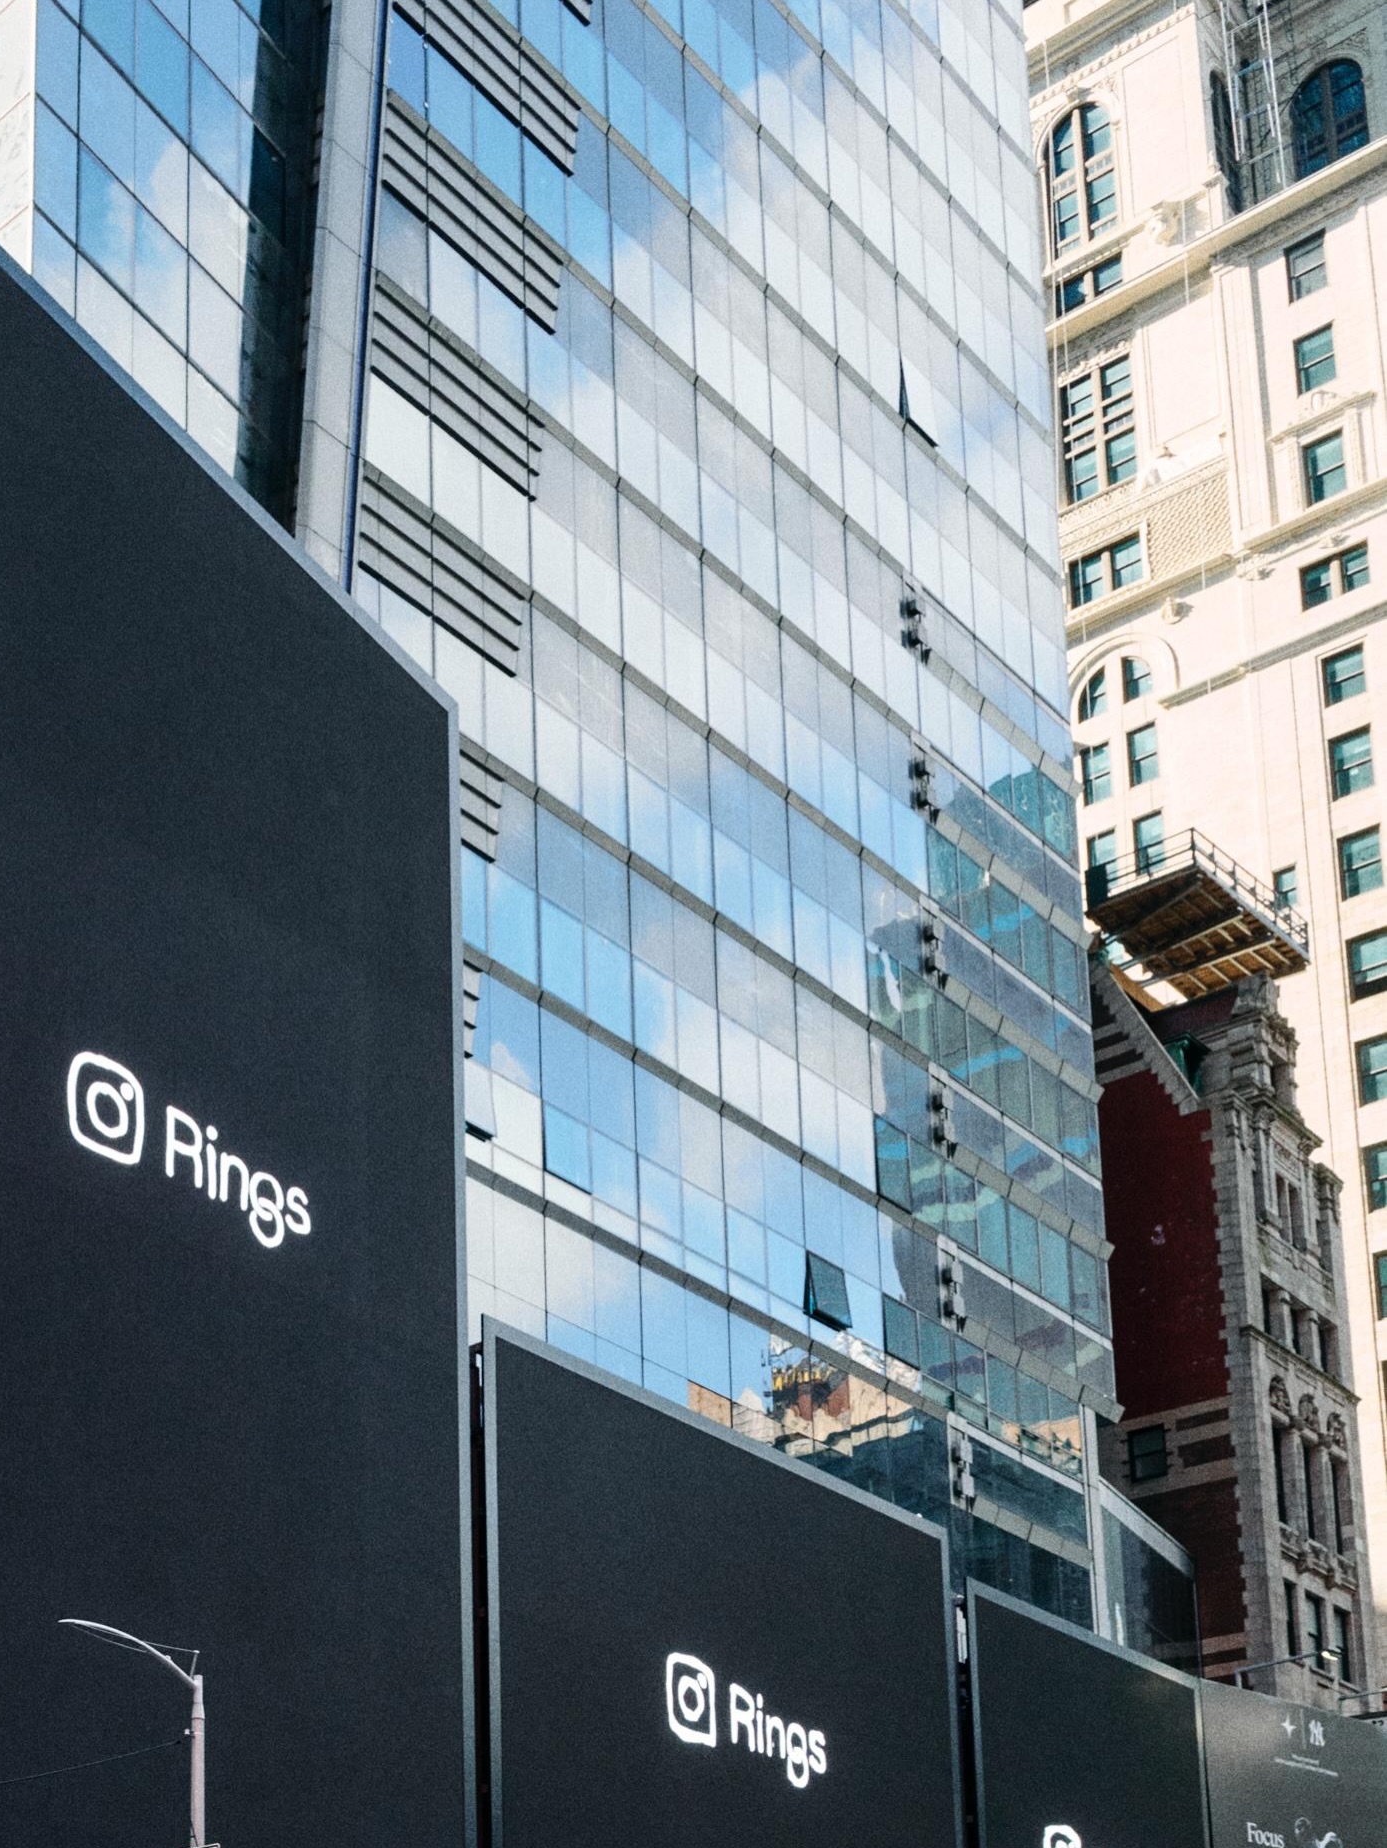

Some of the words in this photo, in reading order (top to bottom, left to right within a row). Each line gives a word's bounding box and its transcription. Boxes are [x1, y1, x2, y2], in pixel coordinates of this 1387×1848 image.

[165, 1105, 312, 1249] Rings
[729, 1683, 827, 1788] Rings
[1246, 1822, 1285, 1848] Focus
